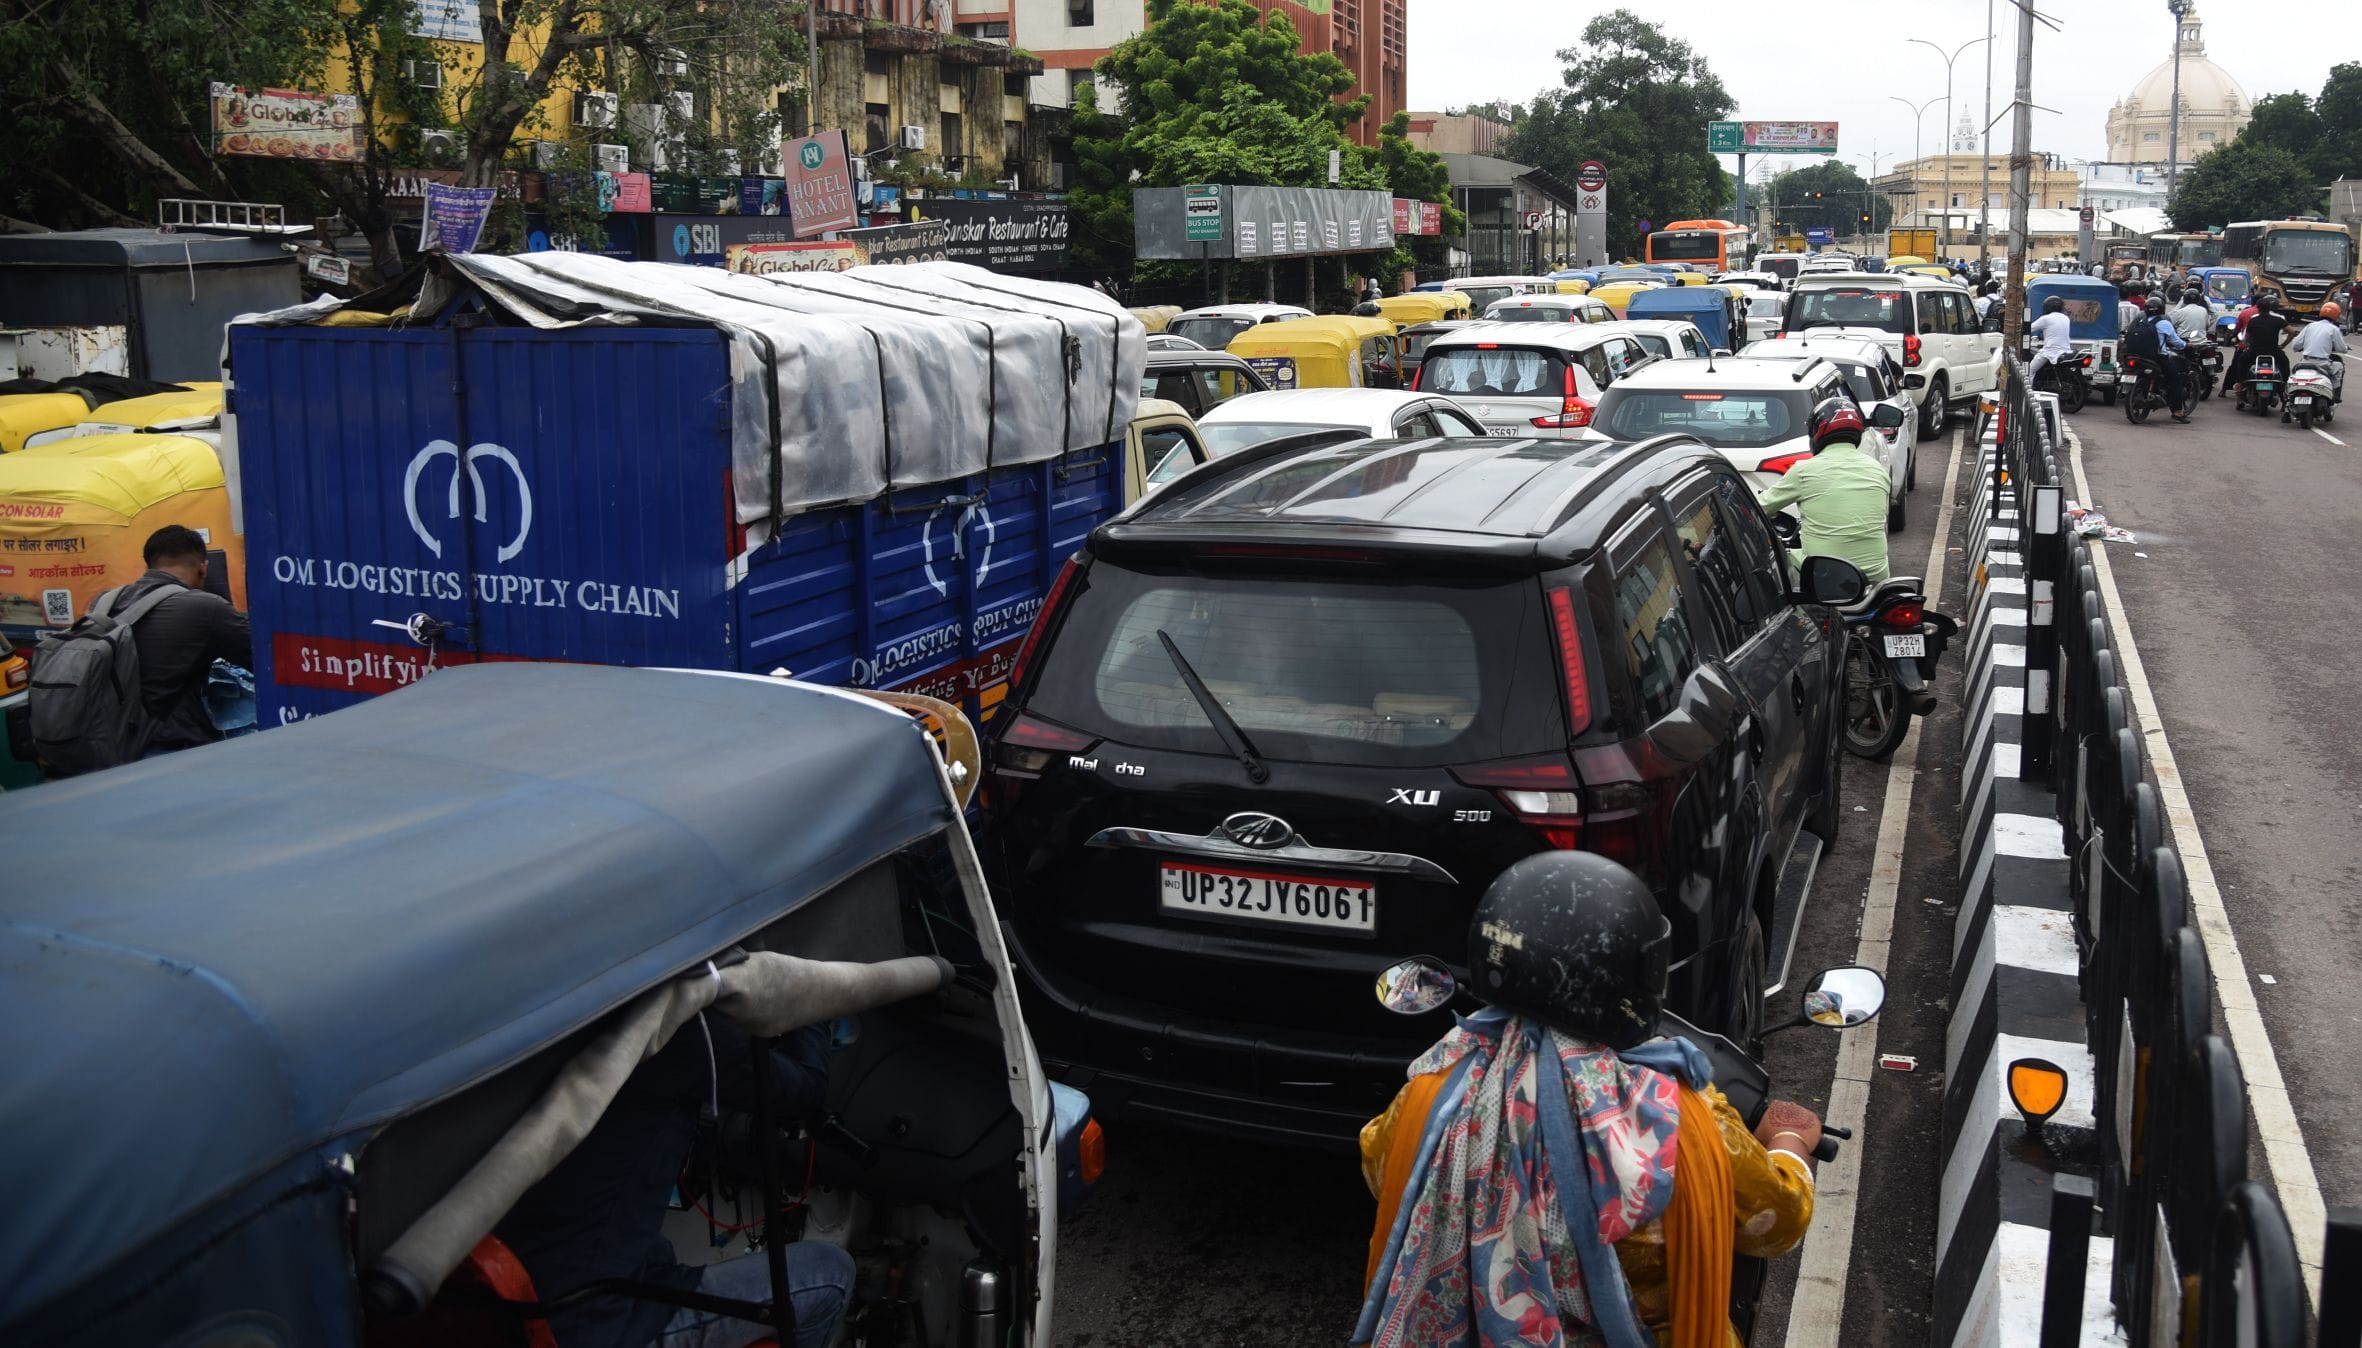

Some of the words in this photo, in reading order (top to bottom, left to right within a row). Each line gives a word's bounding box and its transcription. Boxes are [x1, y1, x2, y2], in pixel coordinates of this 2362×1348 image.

[793, 174, 845, 200] HOTEL
[794, 192, 848, 220] ANANT
[944, 216, 986, 242] Sanskar
[989, 215, 1041, 240] Restaurant
[1040, 215, 1049, 239] &
[1050, 214, 1069, 239] Cafe
[1188, 219, 1202, 227] BUS
[692, 224, 720, 254] SBI
[885, 231, 922, 252] Restaurant
[922, 231, 928, 247] &
[929, 230, 943, 247] Cafe
[988, 246, 1004, 254] SOUTH
[0, 504, 24, 517] CON
[25, 505, 64, 519] SOLAR
[4, 539, 14, 551] पर
[18, 536, 41, 551] सोलर
[29, 564, 67, 579] आइकॉन
[273, 555, 317, 587] OM
[323, 559, 462, 601] LOGISTICS
[577, 580, 680, 620] CHAIN
[1453, 809, 1492, 822] 500
[1182, 870, 1368, 922] UP32JY6061
